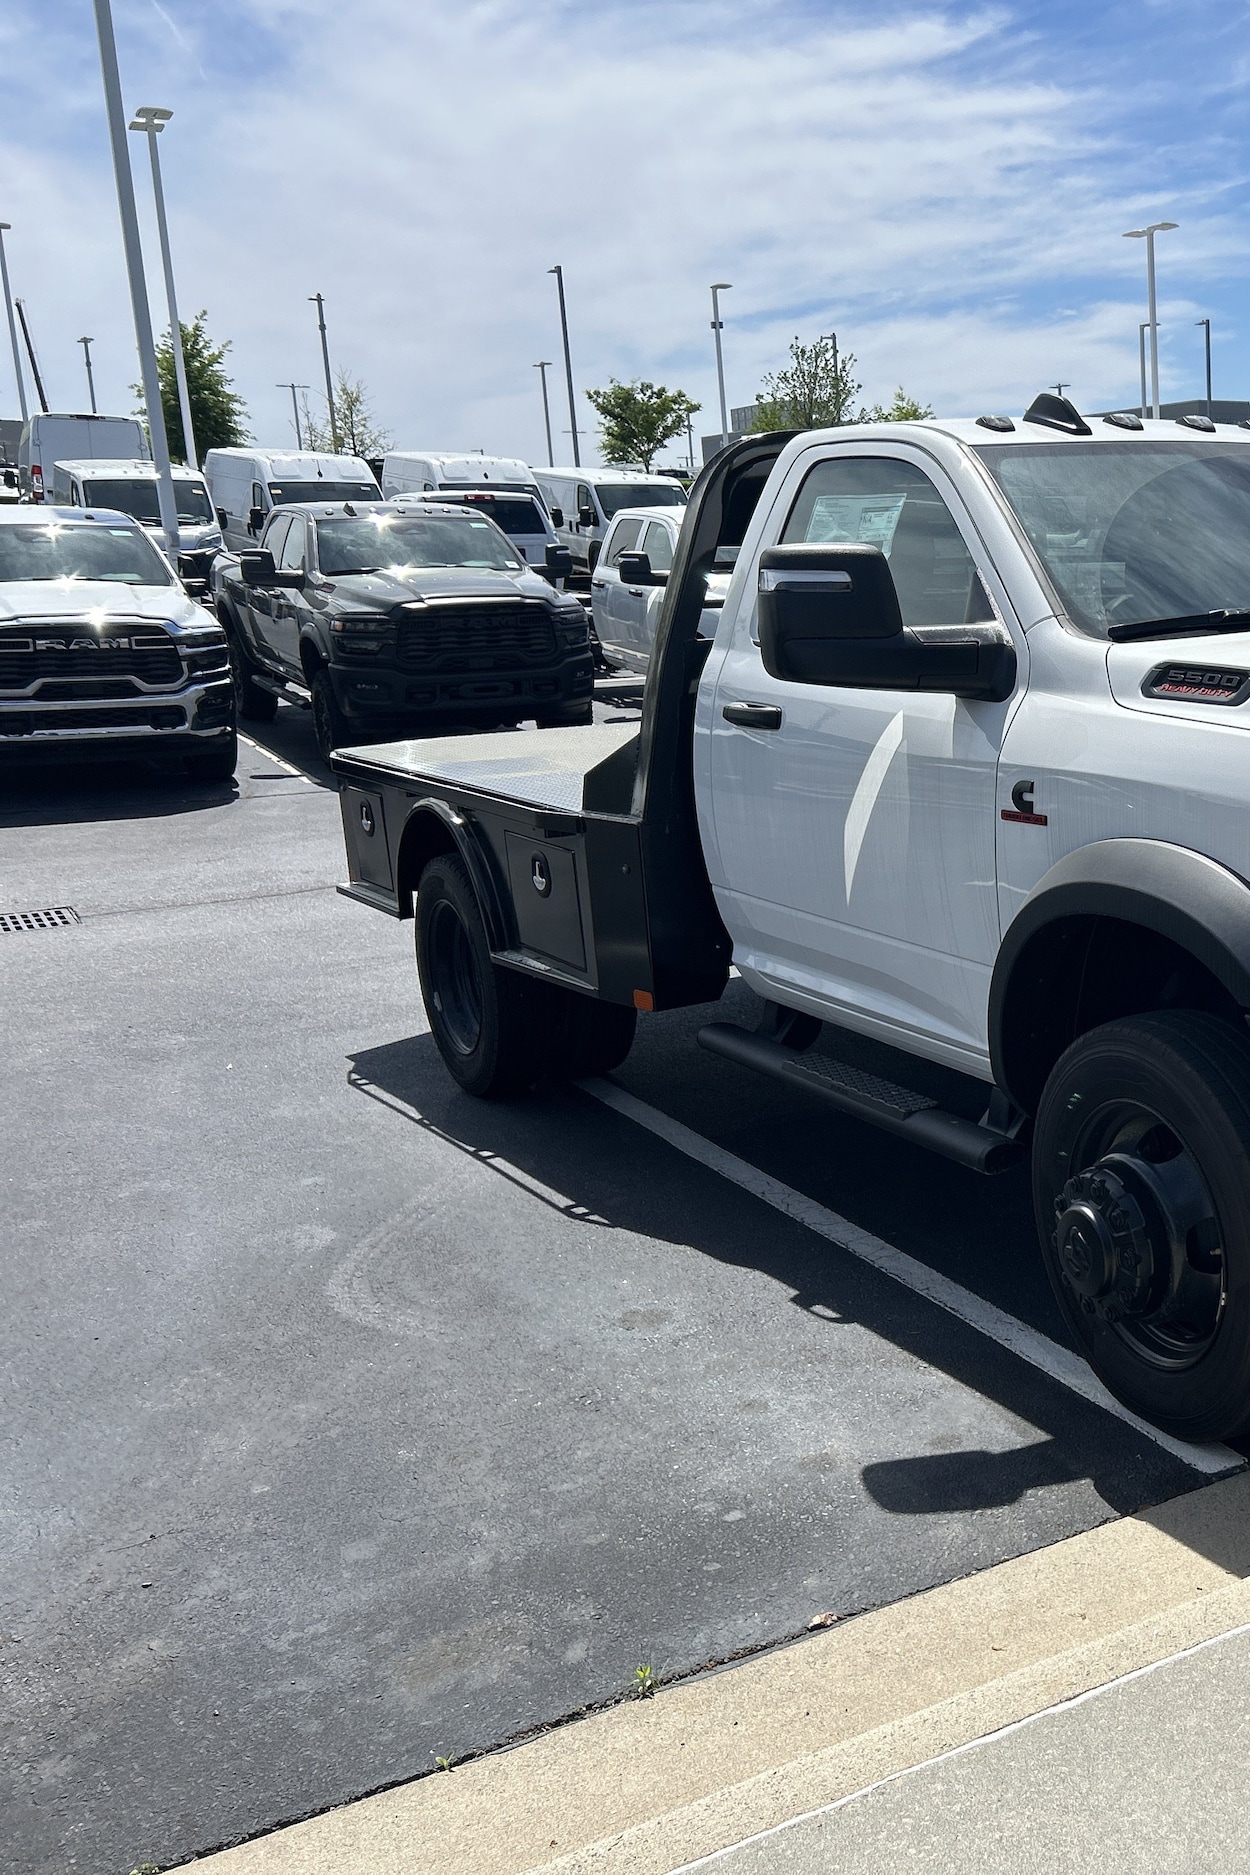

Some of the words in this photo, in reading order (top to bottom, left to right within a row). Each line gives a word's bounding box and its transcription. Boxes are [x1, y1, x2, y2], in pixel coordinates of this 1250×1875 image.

[36, 637, 130, 650] RAM
[1167, 669, 1241, 687] 5500
[1199, 687, 1234, 698] DUTY
